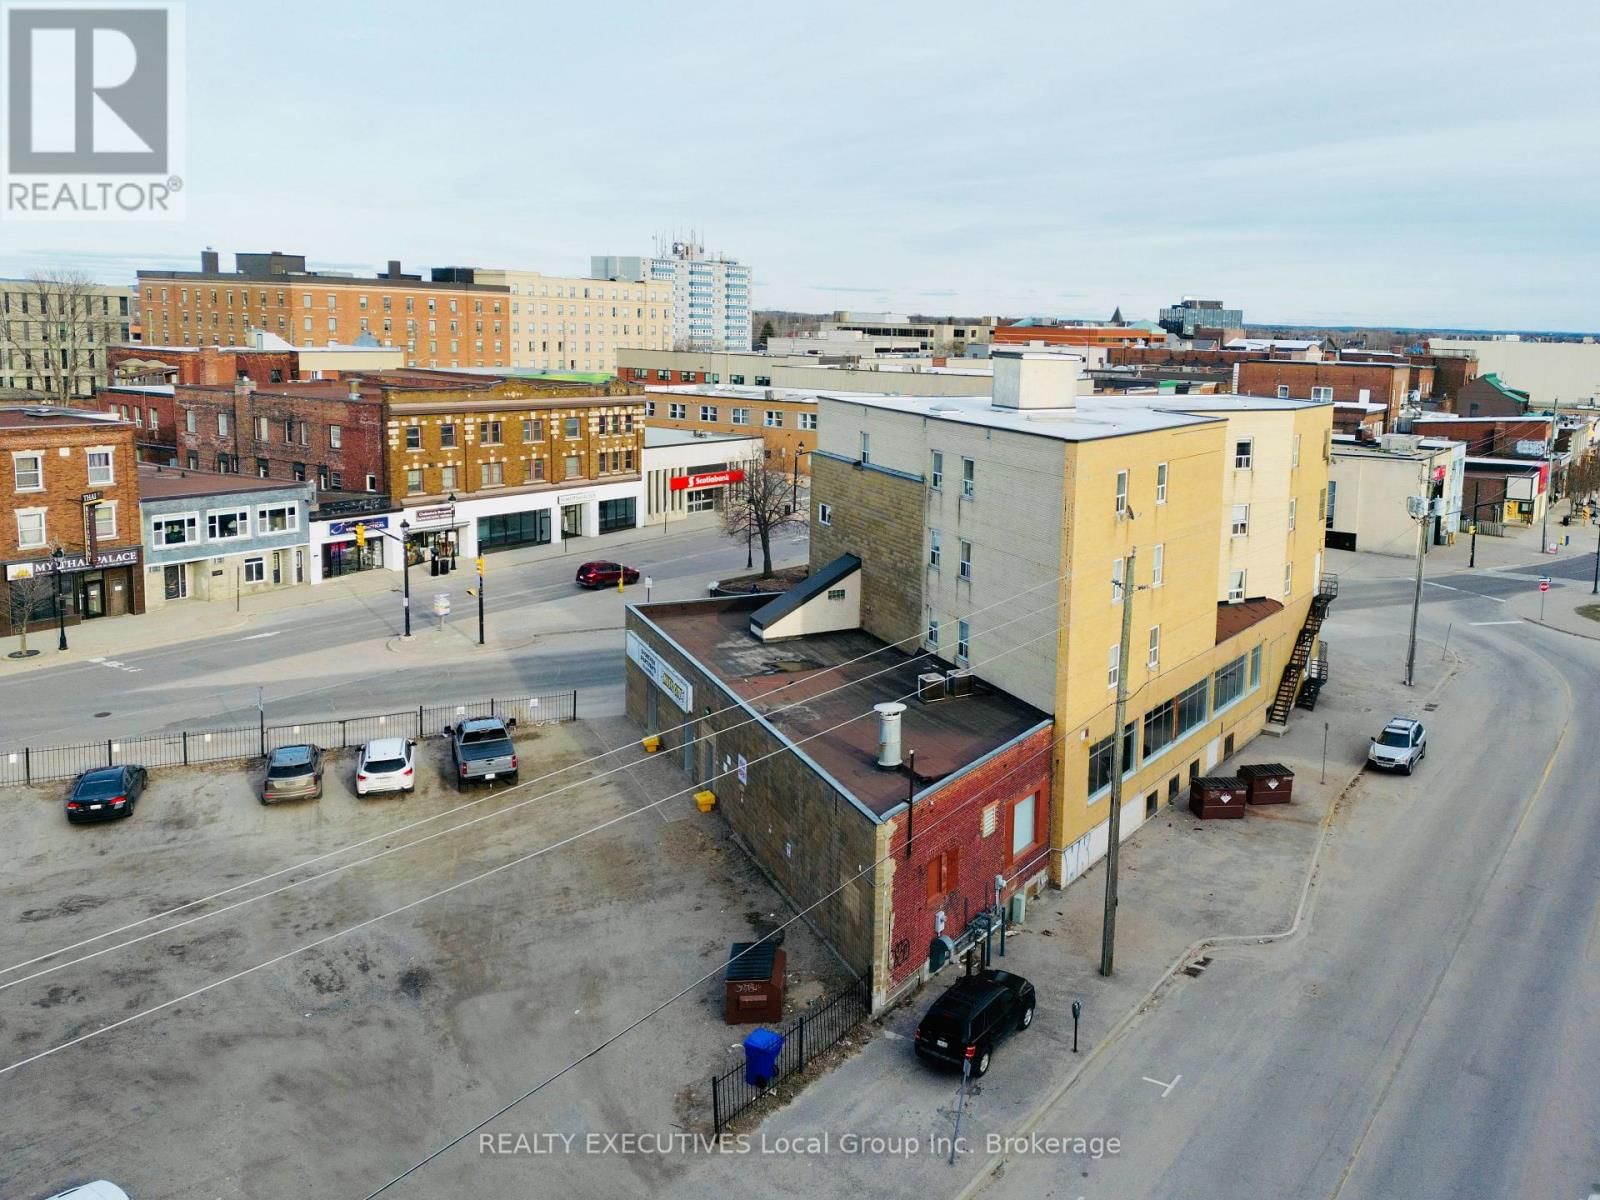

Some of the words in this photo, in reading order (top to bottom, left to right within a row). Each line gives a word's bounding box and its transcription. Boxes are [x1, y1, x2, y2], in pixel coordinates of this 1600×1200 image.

[695, 473, 730, 485] Scotiabank
[83, 493, 97, 501] THAI
[35, 561, 53, 573] MY
